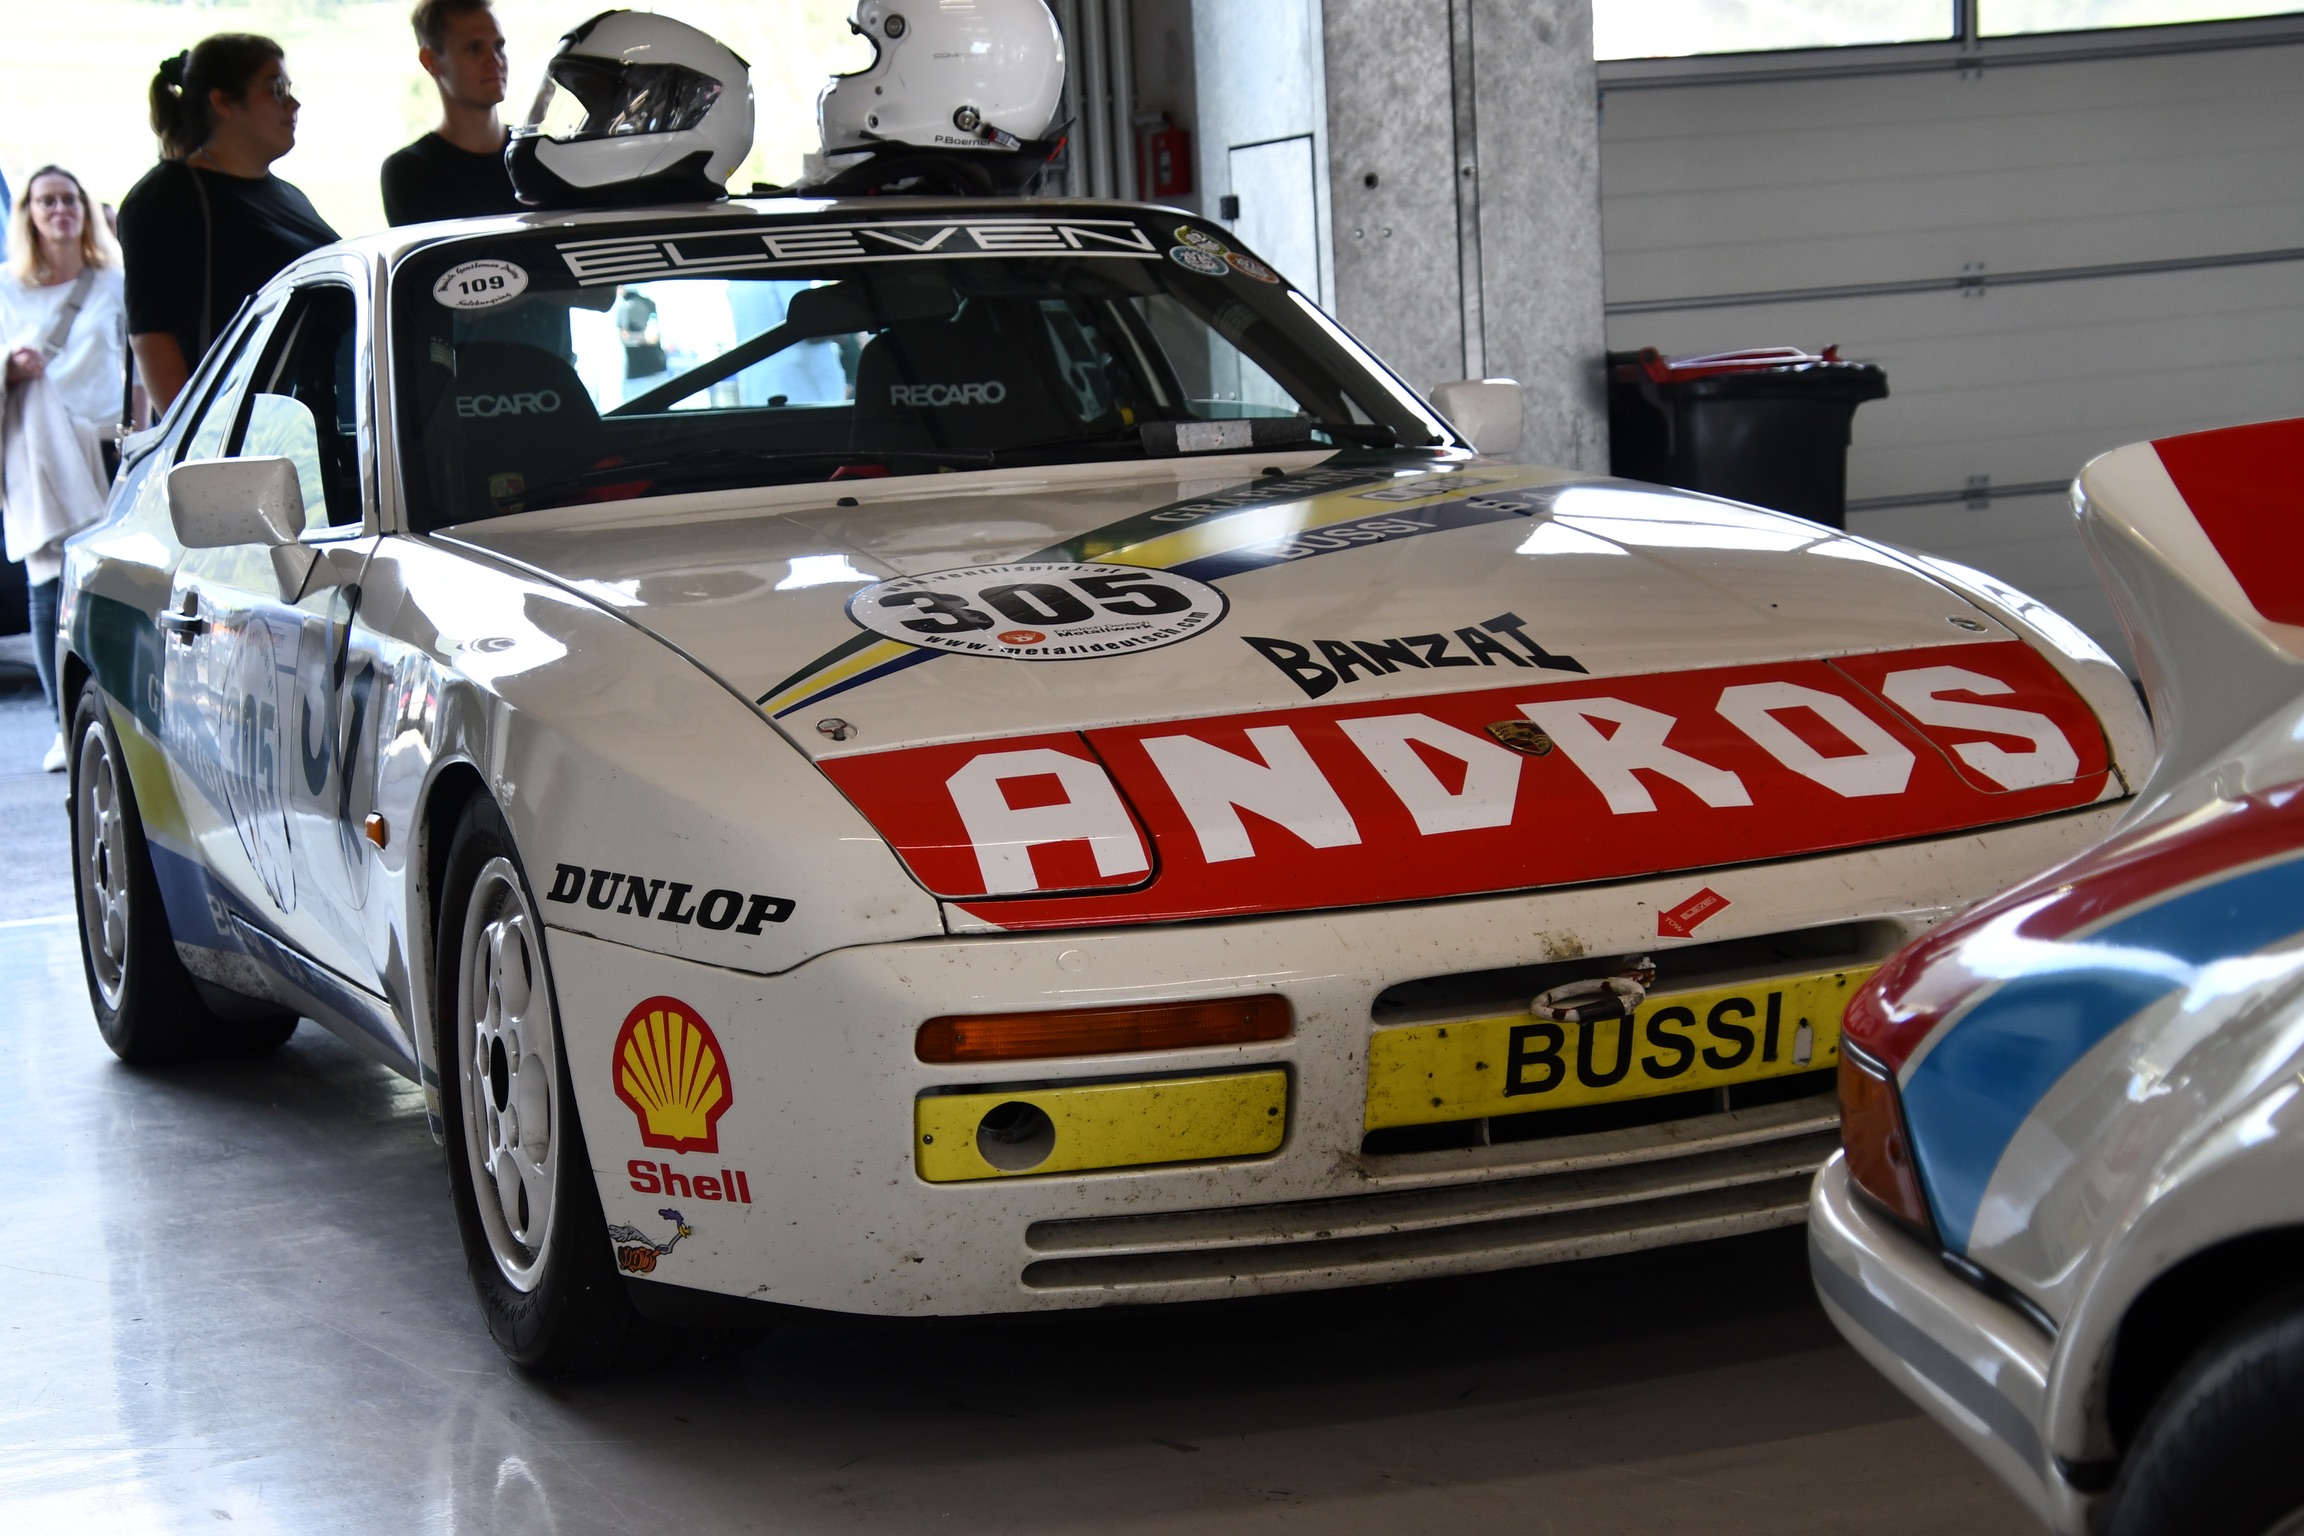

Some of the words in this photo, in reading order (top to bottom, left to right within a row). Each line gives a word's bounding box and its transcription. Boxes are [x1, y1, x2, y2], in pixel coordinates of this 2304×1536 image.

[560, 222, 1154, 279] ELEVEN
[458, 275, 505, 295] 109
[457, 390, 561, 417] ECARO
[890, 381, 1006, 407] RECARO
[878, 573, 1193, 634] 305
[924, 610, 1211, 657] www.metalldeutsch.com
[1243, 613, 1590, 699] BANZAI
[944, 664, 2081, 895] ANDROS
[547, 863, 797, 936] DUNLOP
[1665, 917, 1684, 932] TOW
[1504, 992, 1782, 1098] BUSSI
[627, 1160, 752, 1204] Shell
